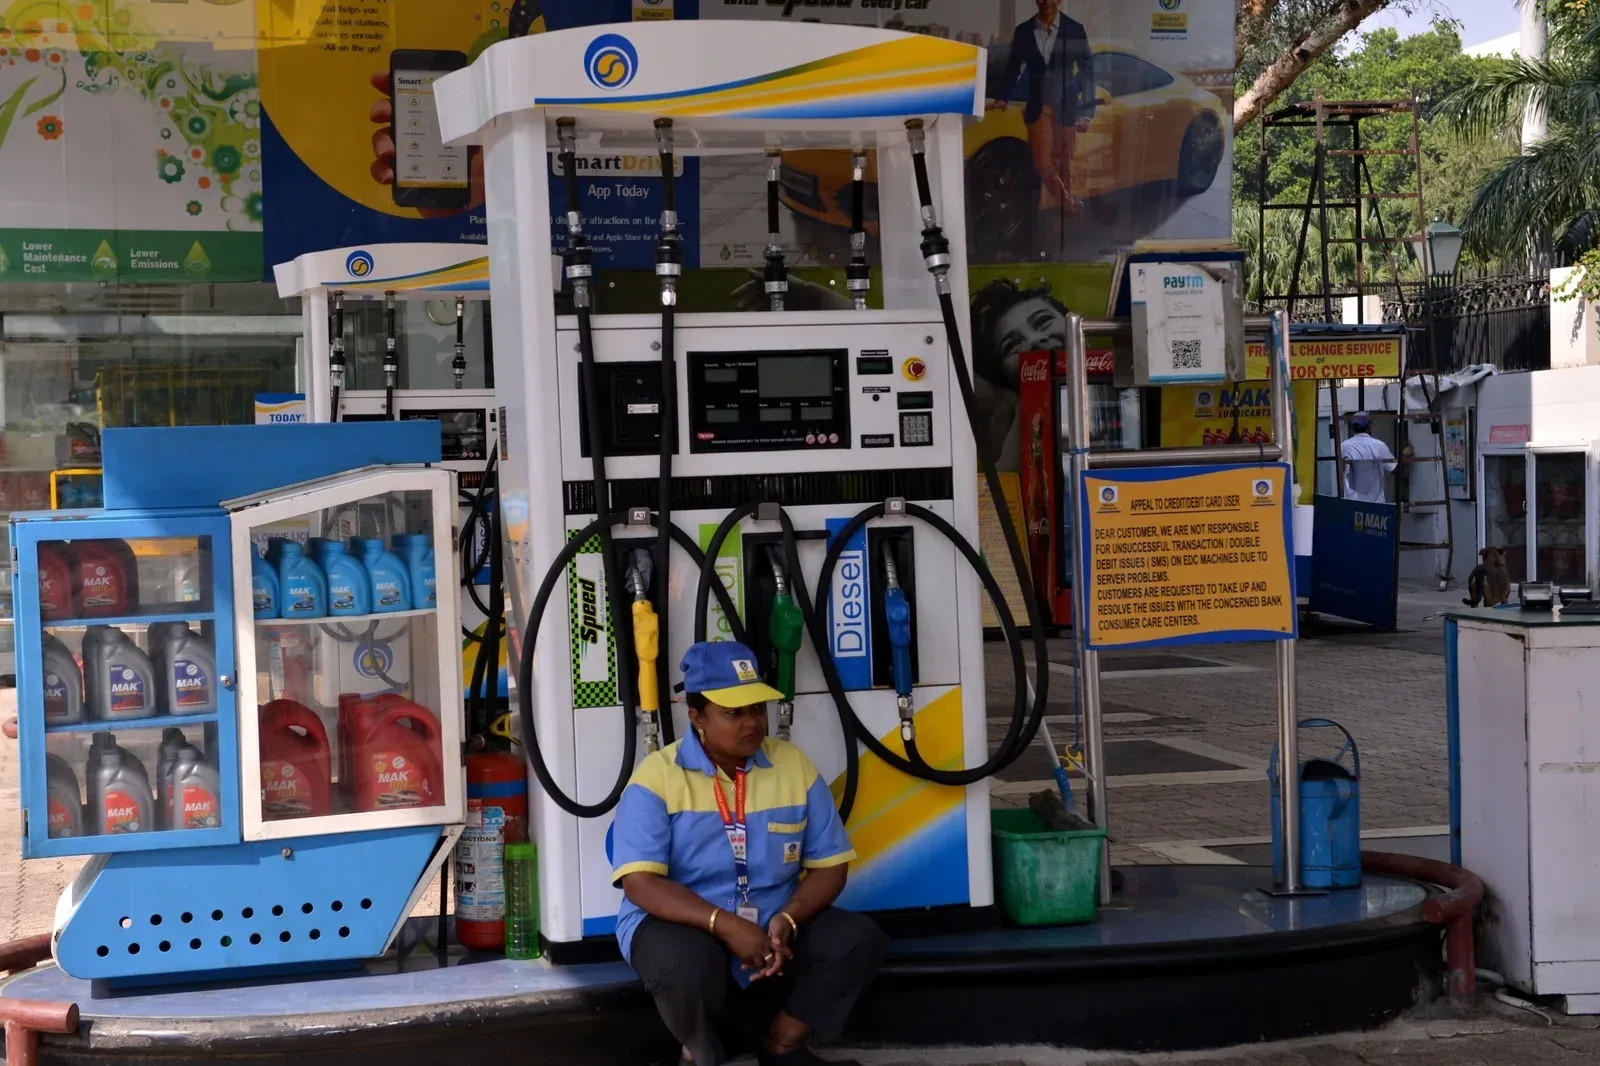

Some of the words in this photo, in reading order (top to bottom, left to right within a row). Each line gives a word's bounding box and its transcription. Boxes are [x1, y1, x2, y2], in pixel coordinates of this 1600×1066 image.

[558, 155, 679, 170] SmartDrie
[588, 184, 611, 199] App
[615, 184, 650, 199] Today
[589, 216, 630, 225] attractions
[632, 217, 642, 225] on
[644, 216, 657, 225] the
[22, 241, 53, 251] Lower
[23, 252, 87, 263] Maintenance
[130, 249, 159, 258] Lower
[24, 263, 47, 273] Cost
[131, 259, 179, 269] Emissions
[1163, 275, 1204, 288] paytm
[1300, 344, 1344, 356] CHANGE
[1346, 342, 1392, 355] SERVICE
[1321, 364, 1375, 377] CYCLES
[1219, 388, 1271, 407] MAK
[1218, 408, 1271, 418] LUBICANTS
[1131, 498, 1154, 511] APPEAL
[1154, 498, 1163, 510] TO
[1205, 495, 1222, 508] CARD
[1223, 495, 1240, 507] USER
[1364, 513, 1388, 531] MAK
[1095, 528, 1115, 540] DEAR
[1160, 525, 1173, 536] WE
[1173, 525, 1189, 536] ARE
[1190, 524, 1206, 535] NOT
[1207, 521, 1260, 534] RESPONSIBLE
[1096, 544, 1111, 555] FOR
[1112, 541, 1171, 554] UNSUCCESSFUL
[1172, 538, 1224, 551] TRANSACTION
[1229, 536, 1260, 548] DOUBLE
[1096, 558, 1117, 570] DEBIT
[1119, 557, 1145, 569] ISSUES
[1170, 555, 1182, 567] ON
[1183, 554, 1199, 566] EDC
[1200, 552, 1239, 565] MACHINES
[1240, 551, 1256, 562] DUE
[1257, 551, 1268, 562] TO
[84, 577, 111, 587] MAK
[1096, 573, 1126, 586] SERVER
[1127, 571, 1170, 583] PROBLEMS.
[289, 587, 310, 595] MAK
[376, 581, 396, 590] MAK
[1097, 587, 1142, 600] CUSTOMERS
[1143, 586, 1159, 598] ARE
[1160, 584, 1205, 597] REQUESTED
[1206, 583, 1217, 595] TO
[1218, 582, 1238, 594] TAKE
[1239, 581, 1250, 593] UP
[1251, 581, 1267, 592] AND
[836, 555, 863, 652] Diesel
[1098, 603, 1132, 616] RESOLVE
[1133, 602, 1148, 614] THE
[1149, 601, 1175, 613] ISSUES
[1177, 599, 1196, 611] WITH
[1197, 598, 1212, 610] THE
[1213, 596, 1260, 609] CONCERNED
[1261, 595, 1283, 607] BANK
[578, 577, 605, 645] Speed
[1098, 618, 1140, 631] CONSUMER
[1141, 617, 1162, 628] CARE
[1163, 614, 1200, 627] CENTERS.
[111, 682, 138, 693] MAK
[176, 677, 202, 688] MAK
[45, 687, 62, 698] AK
[378, 771, 409, 784] MAK
[266, 779, 299, 791] MAK
[107, 807, 134, 817] MAK
[185, 802, 212, 811] MAK
[50, 812, 66, 822] AK
[460, 835, 497, 843] UCTIONS
